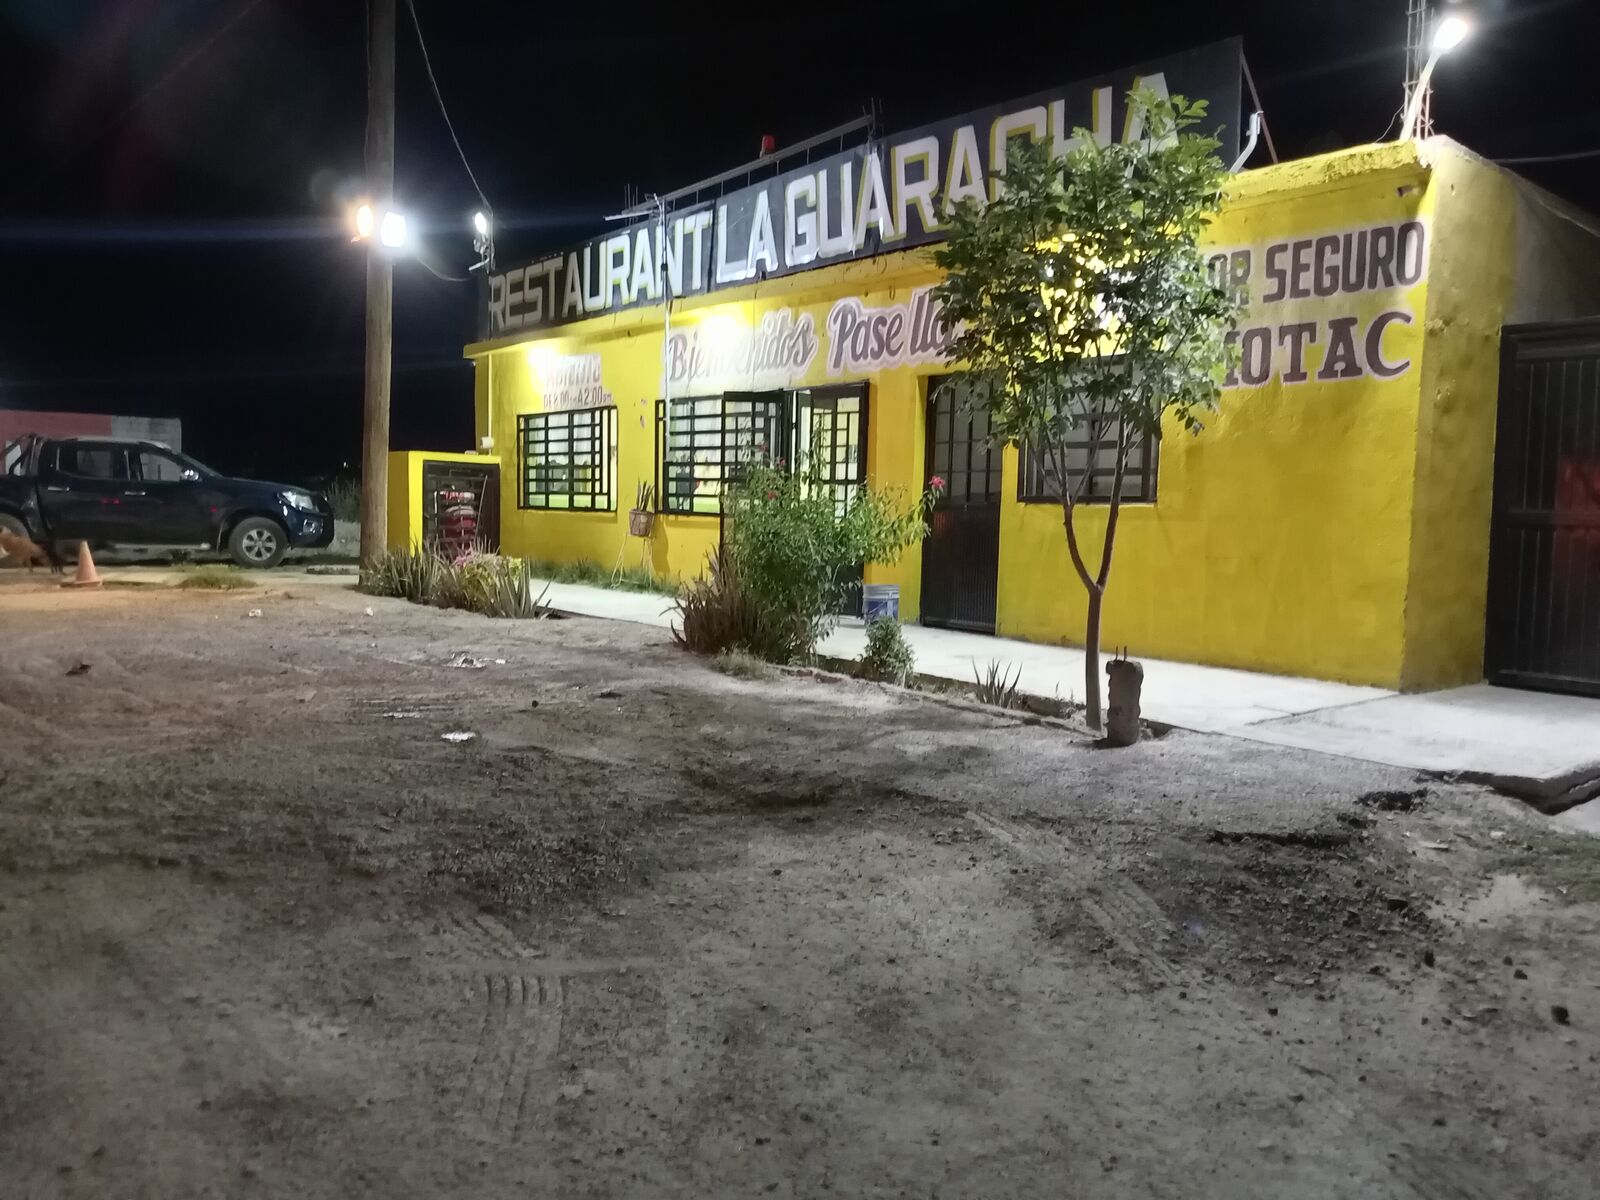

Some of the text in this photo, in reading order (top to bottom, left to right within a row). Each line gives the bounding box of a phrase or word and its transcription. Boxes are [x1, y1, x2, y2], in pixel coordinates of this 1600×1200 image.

[488, 209, 714, 330] RESTAURANT
[715, 190, 779, 284] LA
[1262, 221, 1425, 304] SEGURO
[667, 315, 817, 383] Bienenidos
[831, 303, 904, 369] Pase
